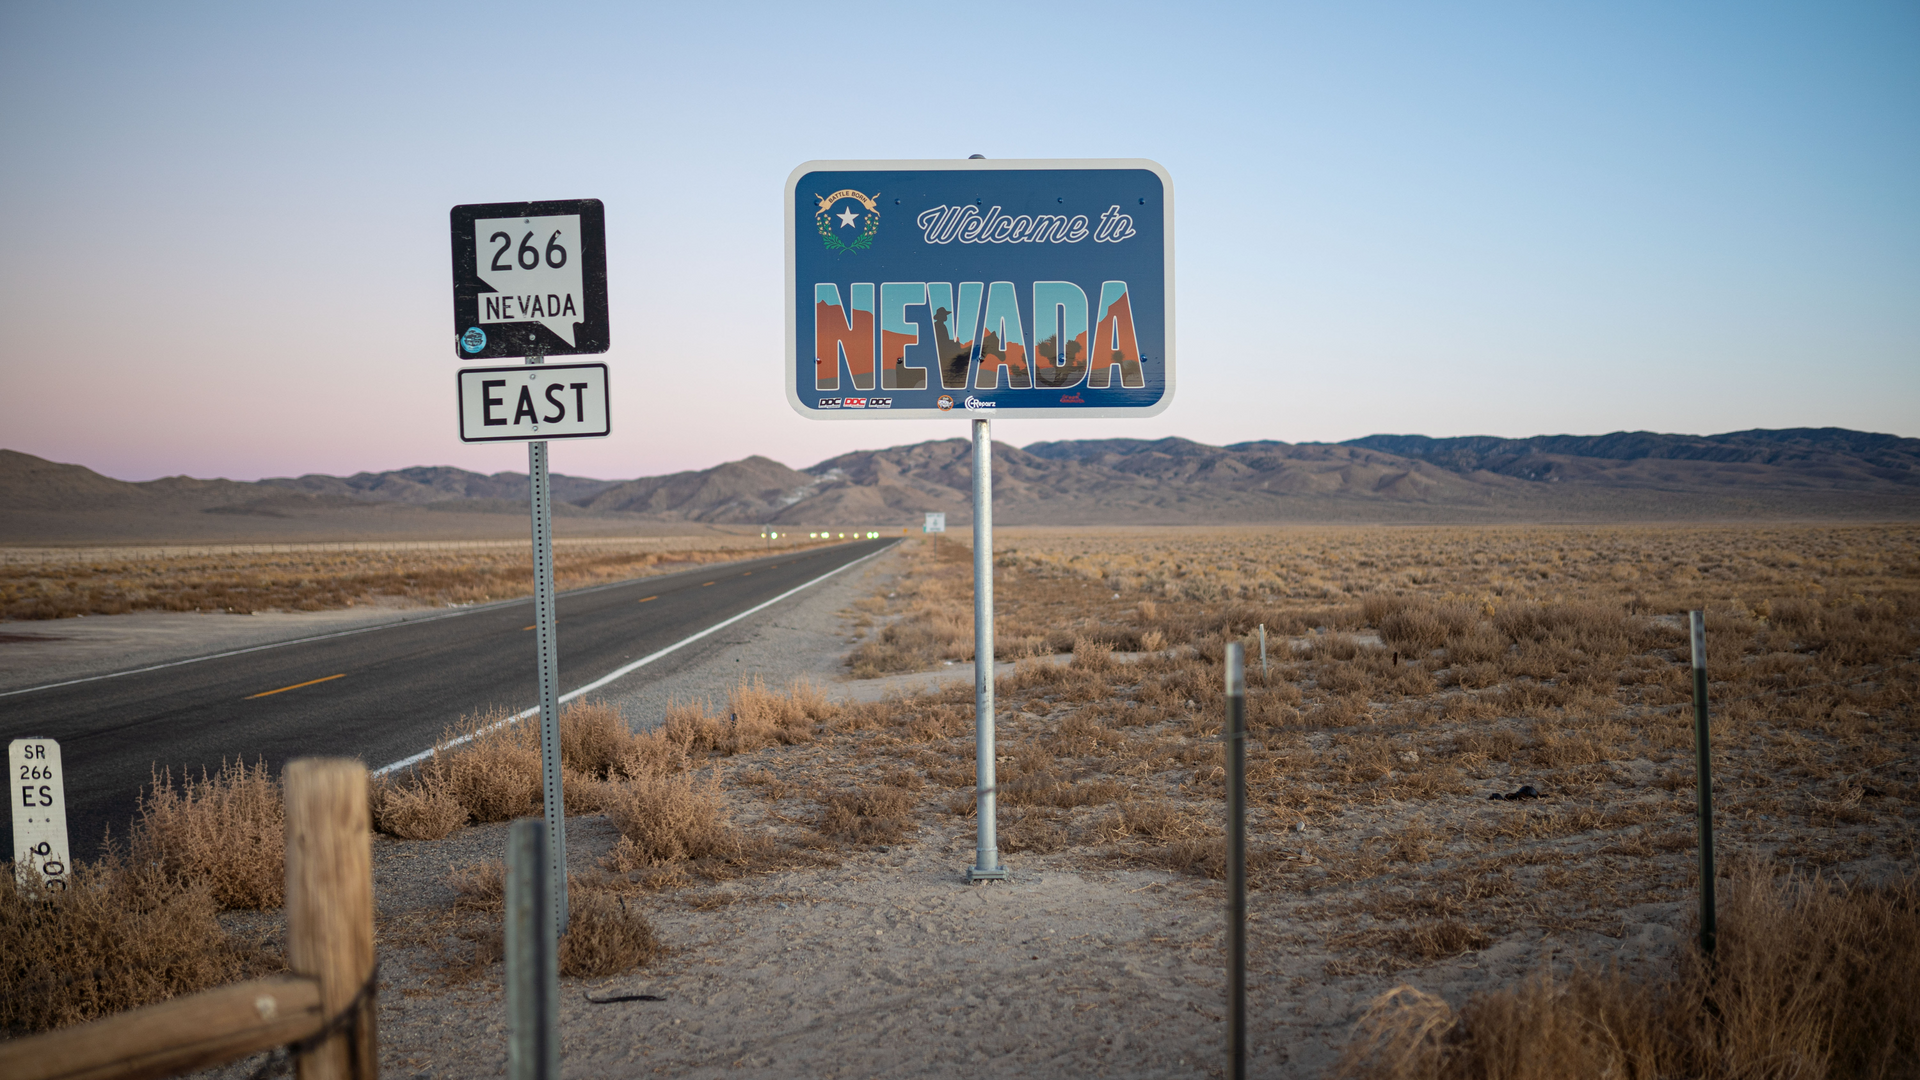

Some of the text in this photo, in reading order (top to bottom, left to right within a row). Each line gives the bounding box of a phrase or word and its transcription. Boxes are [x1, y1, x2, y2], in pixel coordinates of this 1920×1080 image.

[828, 190, 868, 204] BATTLE BORN
[917, 204, 1136, 244] Welcome to
[489, 229, 568, 271] 266
[486, 293, 577, 320] NEVADA
[815, 281, 1145, 391] NEVADA
[482, 379, 588, 427] EAST
[820, 398, 841, 406] DDC
[844, 398, 867, 406] DDC
[870, 398, 892, 406] DDC
[24, 745, 46, 759] SR
[20, 765, 52, 780] 266
[22, 785, 53, 807] ES
